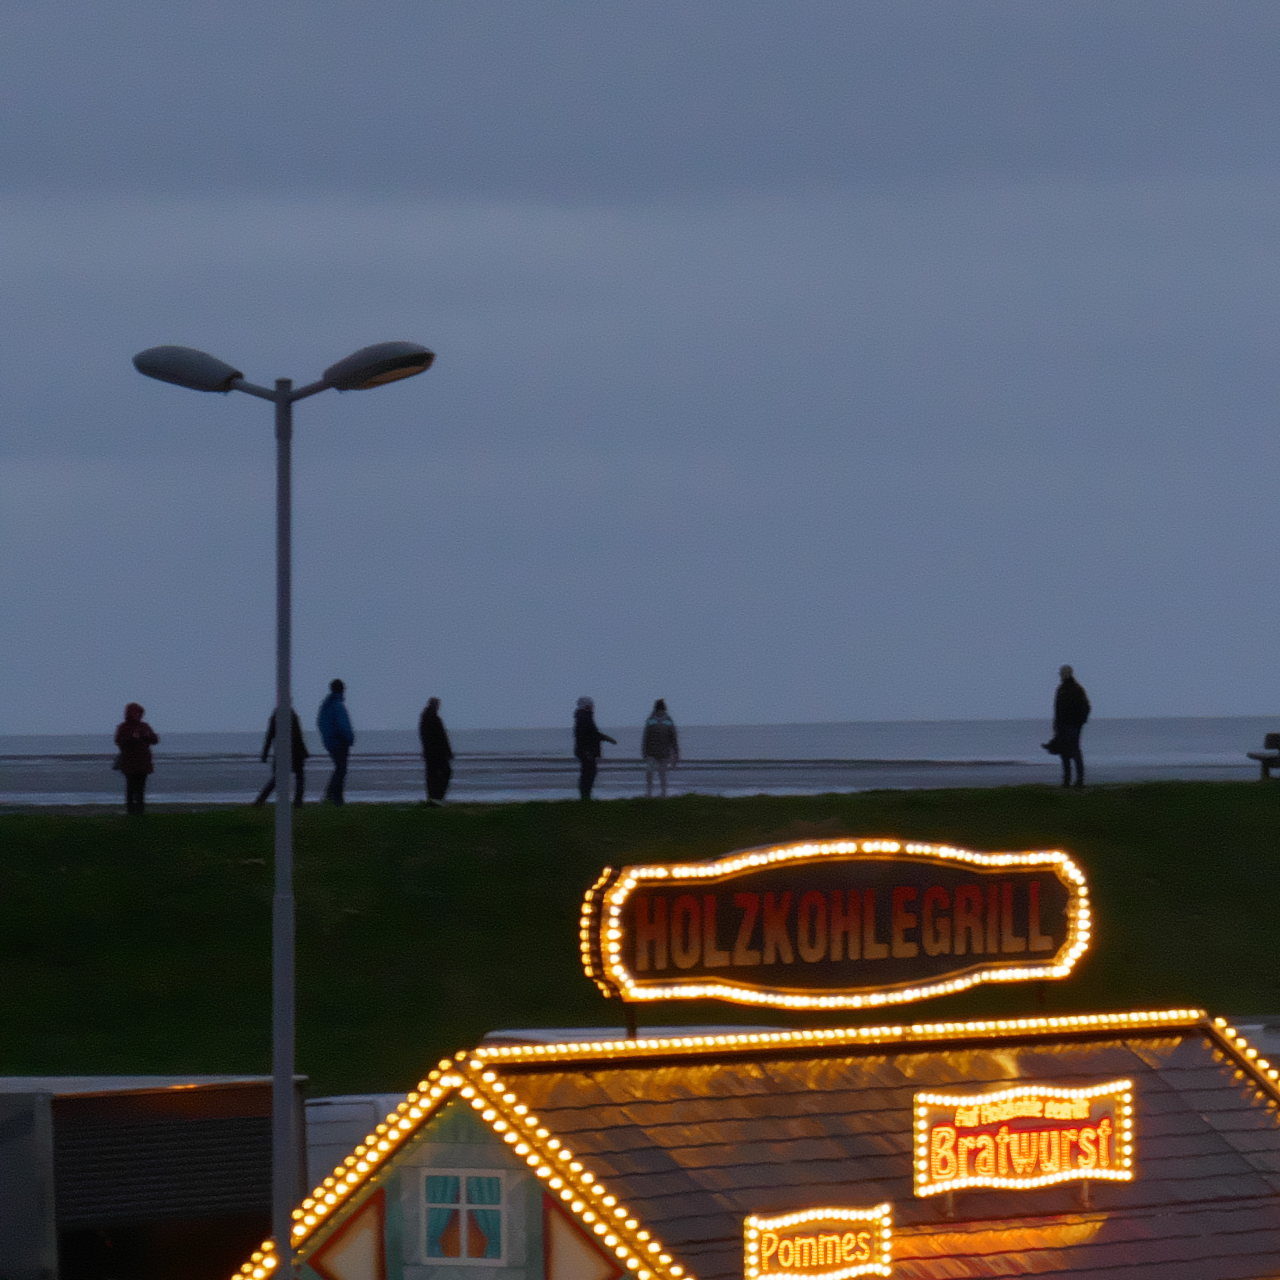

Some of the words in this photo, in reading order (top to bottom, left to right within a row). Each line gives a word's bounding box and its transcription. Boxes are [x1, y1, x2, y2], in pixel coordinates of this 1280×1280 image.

[635, 880, 1054, 972] HOLZKOHLEGRILL
[930, 1117, 1112, 1180] Bratwurst
[760, 1229, 871, 1270] Pommes
